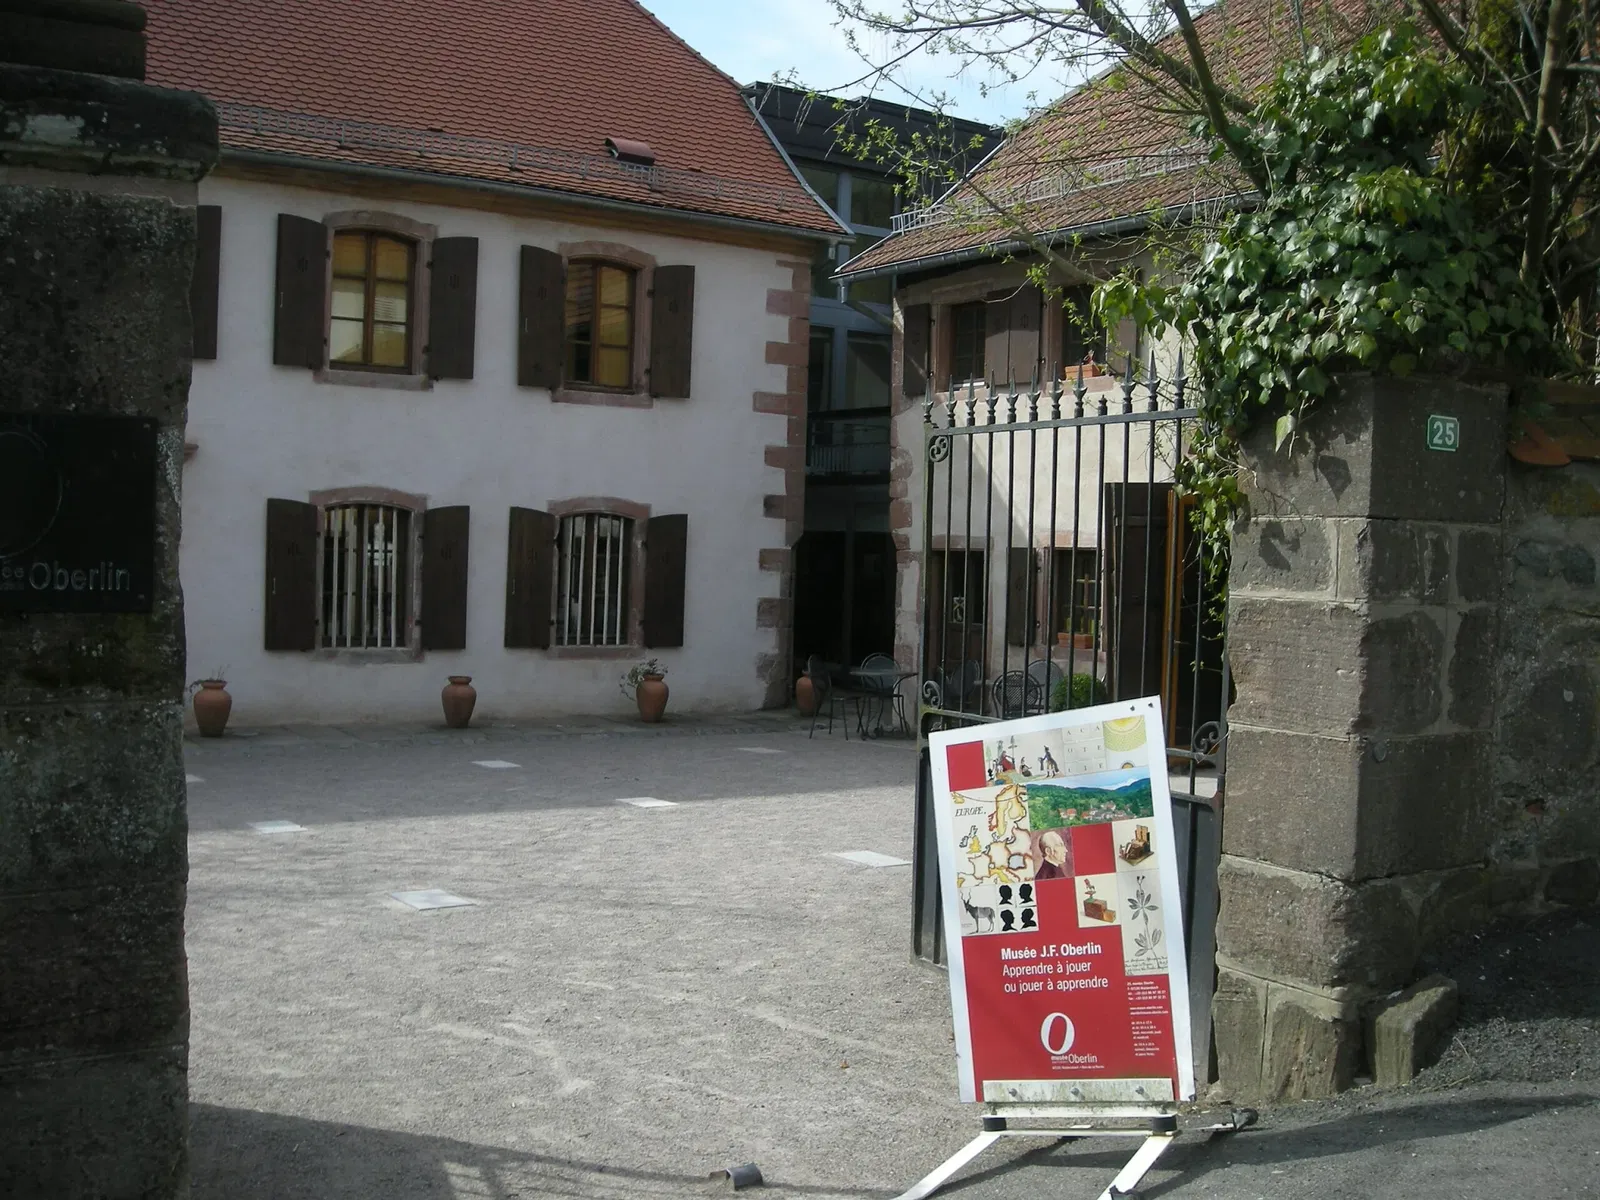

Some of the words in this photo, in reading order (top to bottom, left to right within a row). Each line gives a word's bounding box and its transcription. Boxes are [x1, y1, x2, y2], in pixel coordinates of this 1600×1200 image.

[1433, 421, 1455, 445] 25
[28, 561, 131, 591] Oberlin
[1001, 944, 1037, 961] Musée
[1040, 944, 1059, 958] J.F.
[1061, 942, 1102, 957] Oberlin
[1003, 962, 1054, 977] Apprendre
[1056, 960, 1064, 973] à
[1064, 959, 1092, 975] jouer
[1004, 981, 1017, 993] ou
[1018, 979, 1044, 995] jouer
[1047, 977, 1055, 990] à
[1057, 976, 1109, 993] apprendre
[1068, 1053, 1098, 1064] Oberlin
